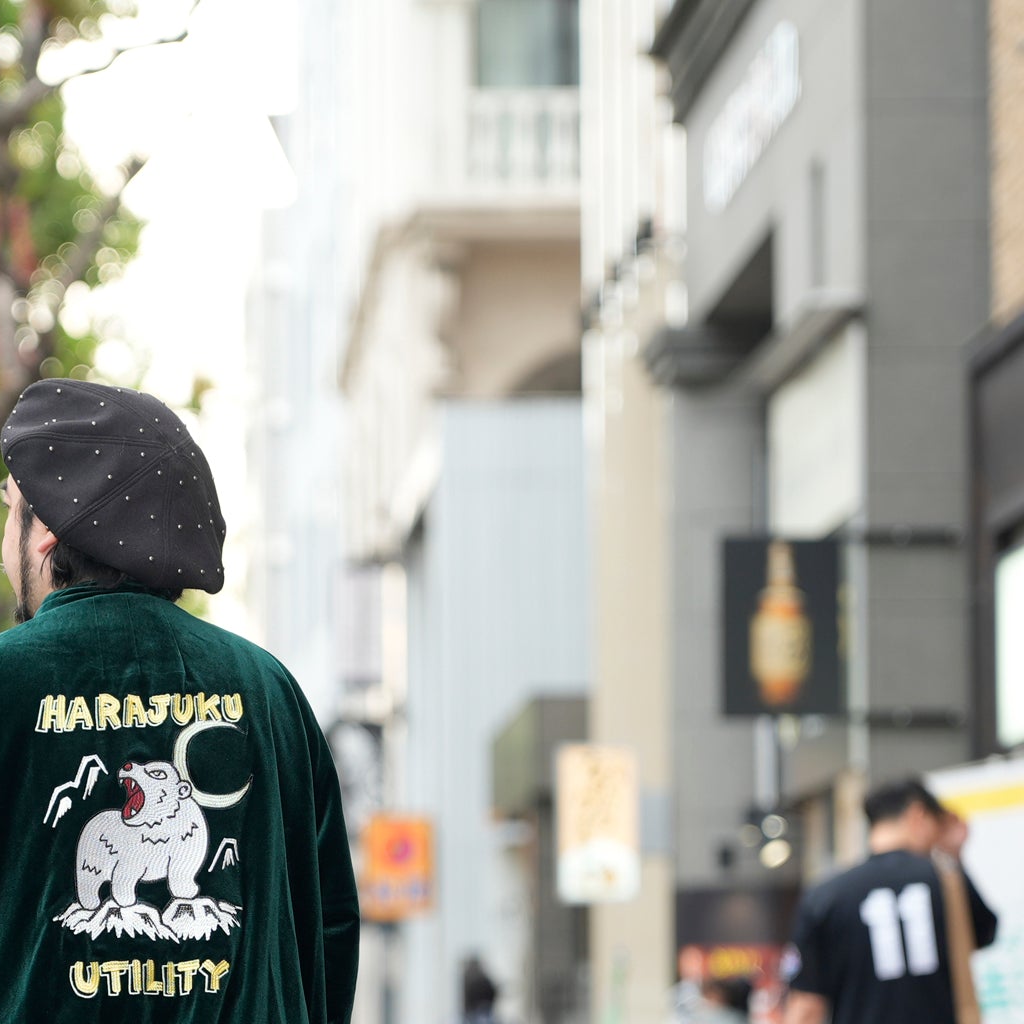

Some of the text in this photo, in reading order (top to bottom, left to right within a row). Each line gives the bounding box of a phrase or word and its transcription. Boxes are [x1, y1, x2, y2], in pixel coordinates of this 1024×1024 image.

[36, 694, 244, 732] HARAJUKU
[859, 882, 939, 981] 11
[70, 959, 229, 998] UTILITY
